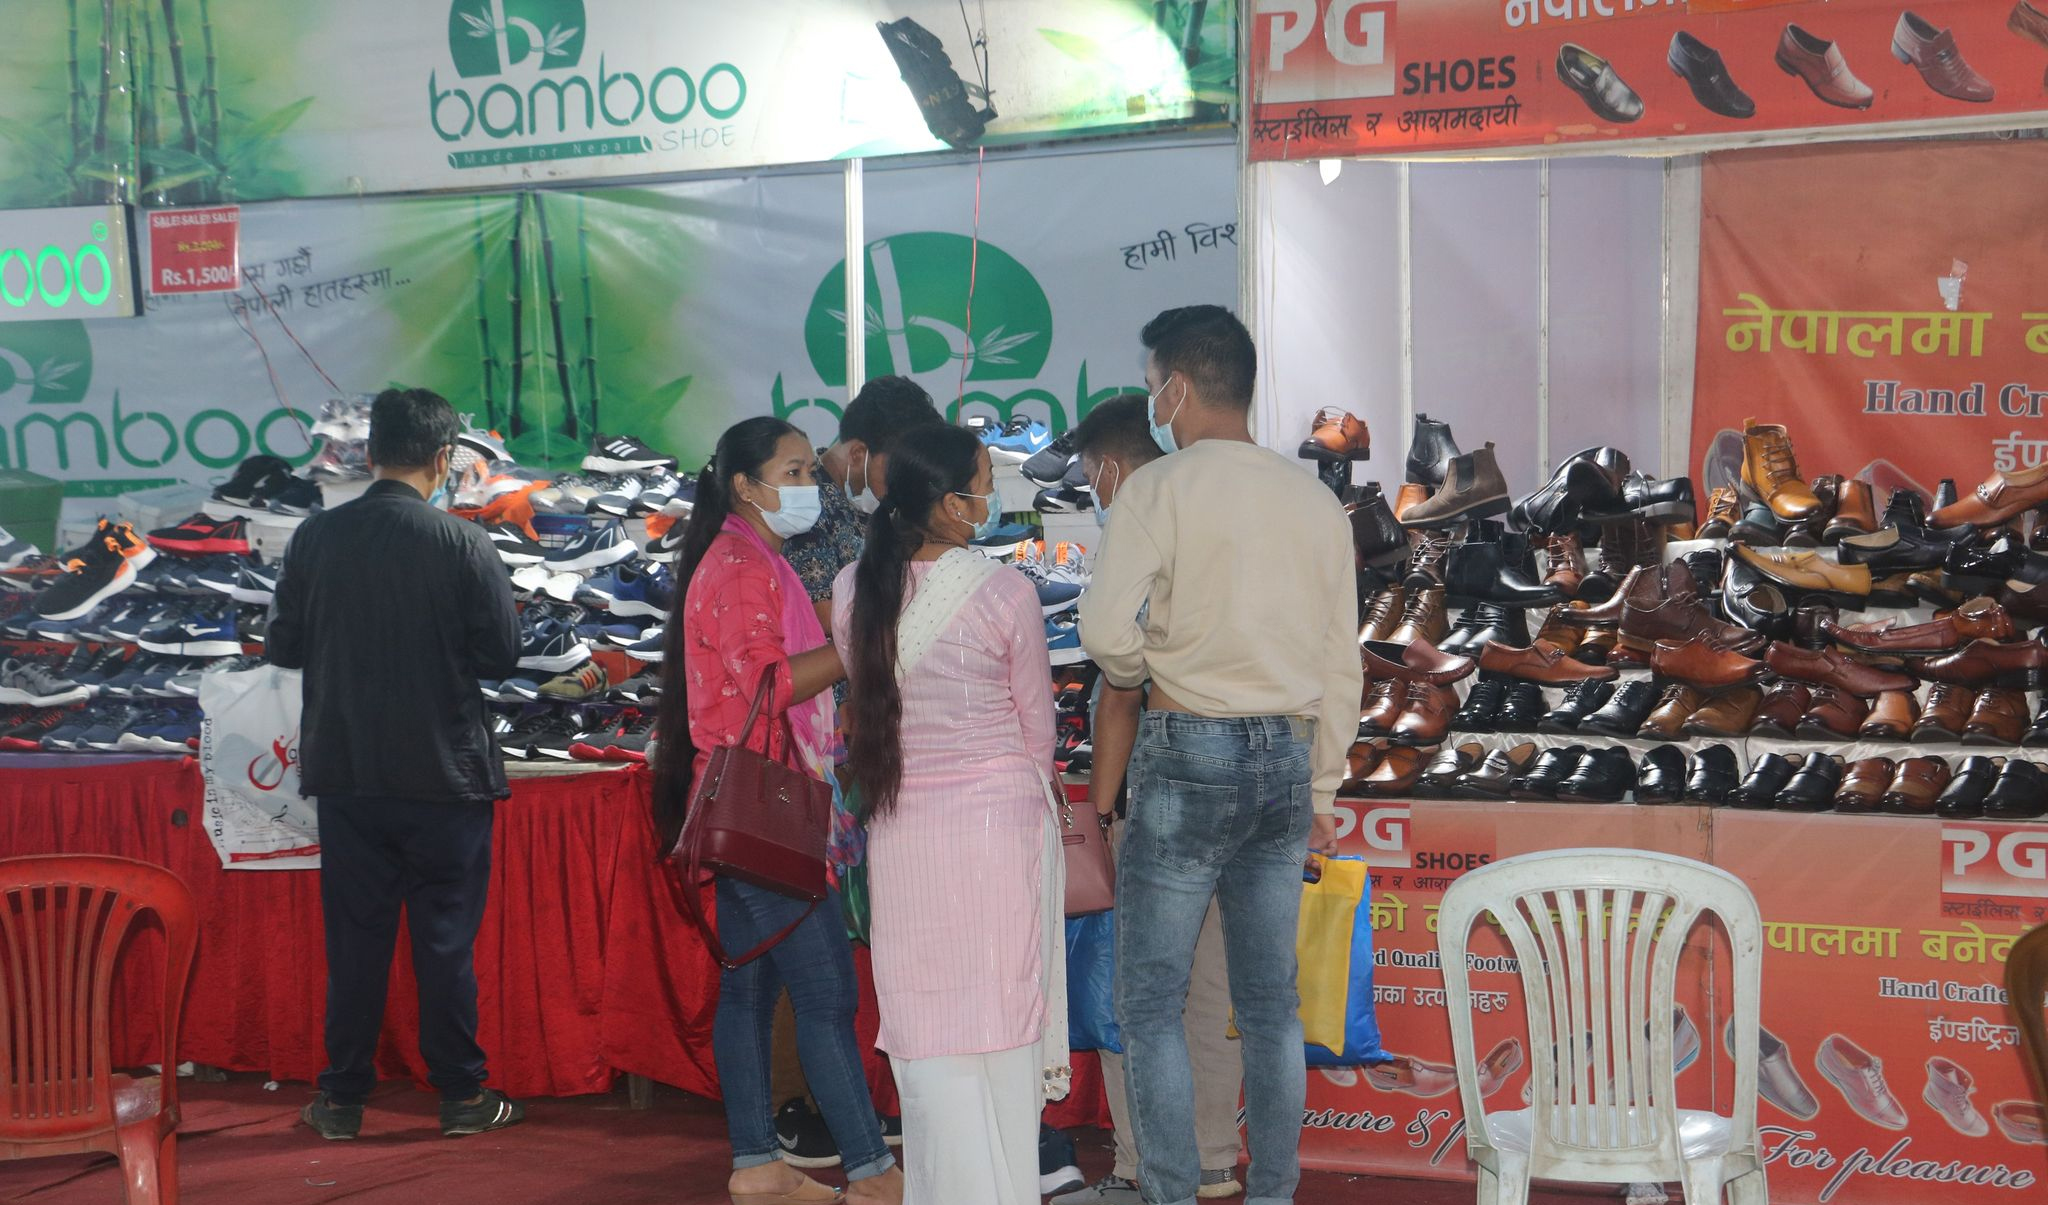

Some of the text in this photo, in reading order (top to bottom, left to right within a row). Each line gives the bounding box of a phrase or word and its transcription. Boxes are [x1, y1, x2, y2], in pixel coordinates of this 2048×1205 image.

[1257, 0, 1385, 71] PG
[429, 51, 747, 142] bamboo
[1402, 56, 1516, 95] SHOES
[1366, 112, 1383, 137] र
[1397, 95, 1521, 137] आरामदायी
[464, 140, 632, 165] Made for Nepal
[658, 125, 736, 151] SHOE
[1120, 229, 1177, 271] हामी
[1722, 292, 1993, 358] नेपालमा
[1862, 379, 1987, 417] Hand
[0, 388, 324, 470] mboo
[203, 718, 214, 761] blood
[1416, 852, 1490, 871] SHOES
[1942, 828, 2048, 880] PG
[1391, 949, 1441, 969] Quali
[1762, 921, 1902, 958] पालमा
[1879, 977, 2009, 1005] Hand Crafte
[1758, 1125, 2036, 1203] For pleasure
